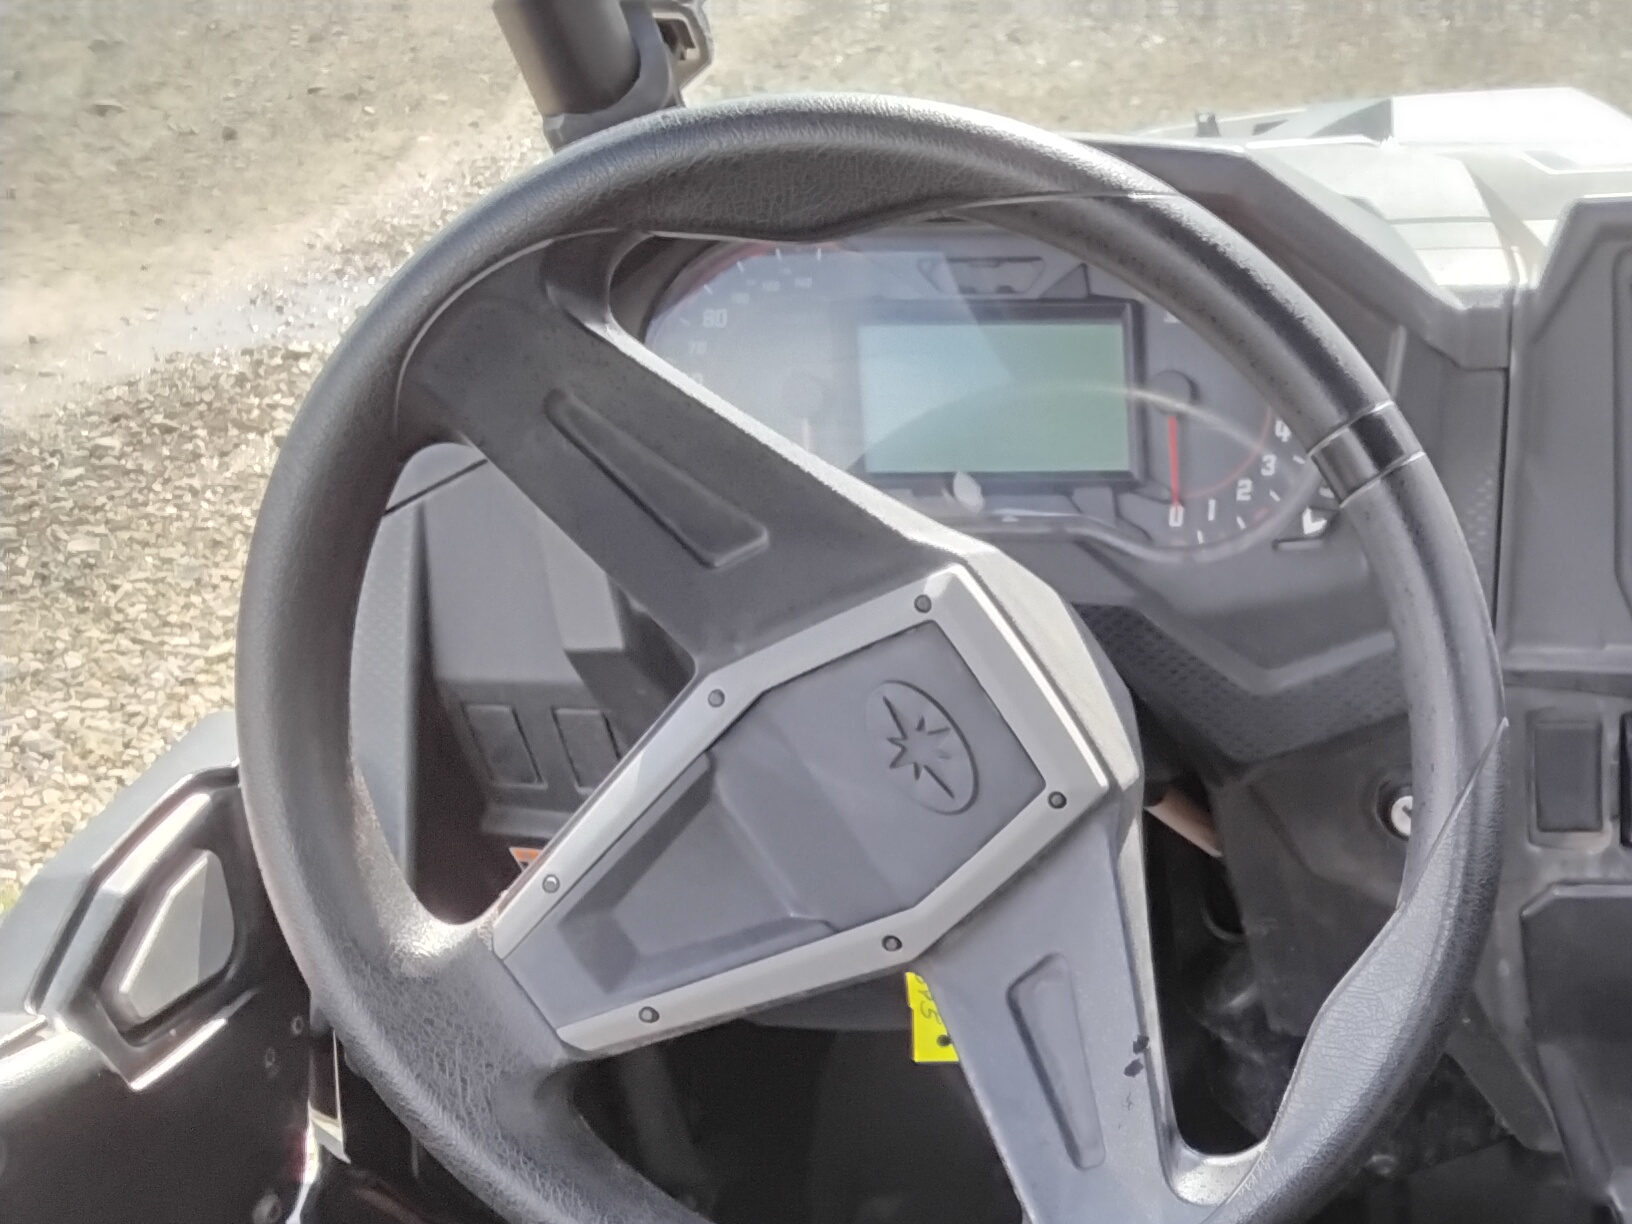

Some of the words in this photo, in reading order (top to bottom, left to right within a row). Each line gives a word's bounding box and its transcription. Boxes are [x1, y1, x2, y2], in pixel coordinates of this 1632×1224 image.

[702, 308, 728, 328] 80
[1275, 418, 1292, 442] 4
[1261, 454, 1278, 476] 3
[1236, 478, 1253, 501] 2
[1168, 504, 1185, 527] 0
[1208, 499, 1217, 521] 1
